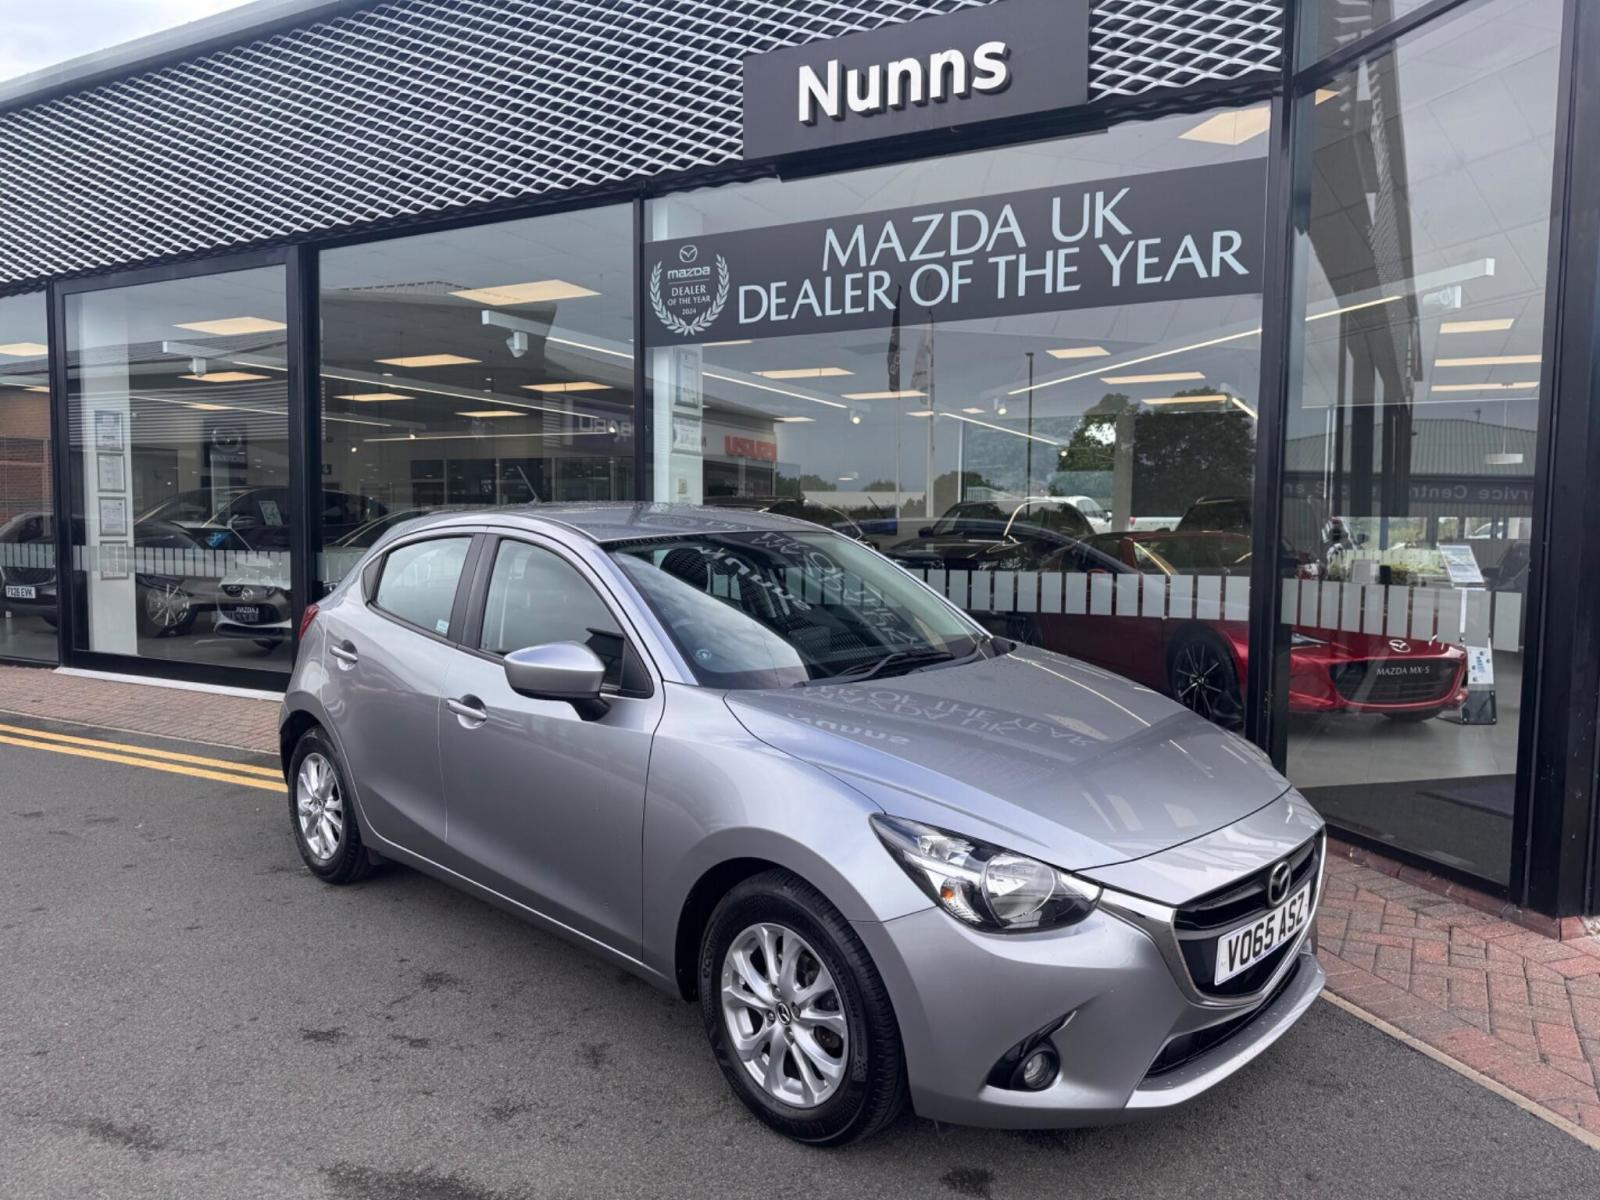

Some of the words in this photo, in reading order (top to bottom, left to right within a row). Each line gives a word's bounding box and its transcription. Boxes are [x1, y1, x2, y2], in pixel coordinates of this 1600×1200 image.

[798, 41, 1008, 123] Nunns
[822, 203, 1027, 271] MAZDA
[1051, 187, 1133, 243] UK
[667, 298, 677, 306] OF
[679, 296, 691, 305] THE
[693, 295, 711, 304] YEAR
[671, 285, 707, 297] DEALER
[737, 270, 897, 325] DEALER
[909, 259, 974, 307] OF
[988, 247, 1081, 300] THE
[1098, 229, 1249, 287] YEAR
[1376, 665, 1407, 675] MAZDA
[1409, 664, 1430, 674] MX-5
[1228, 914, 1276, 972] VO65
[1278, 890, 1305, 942] ASZ
